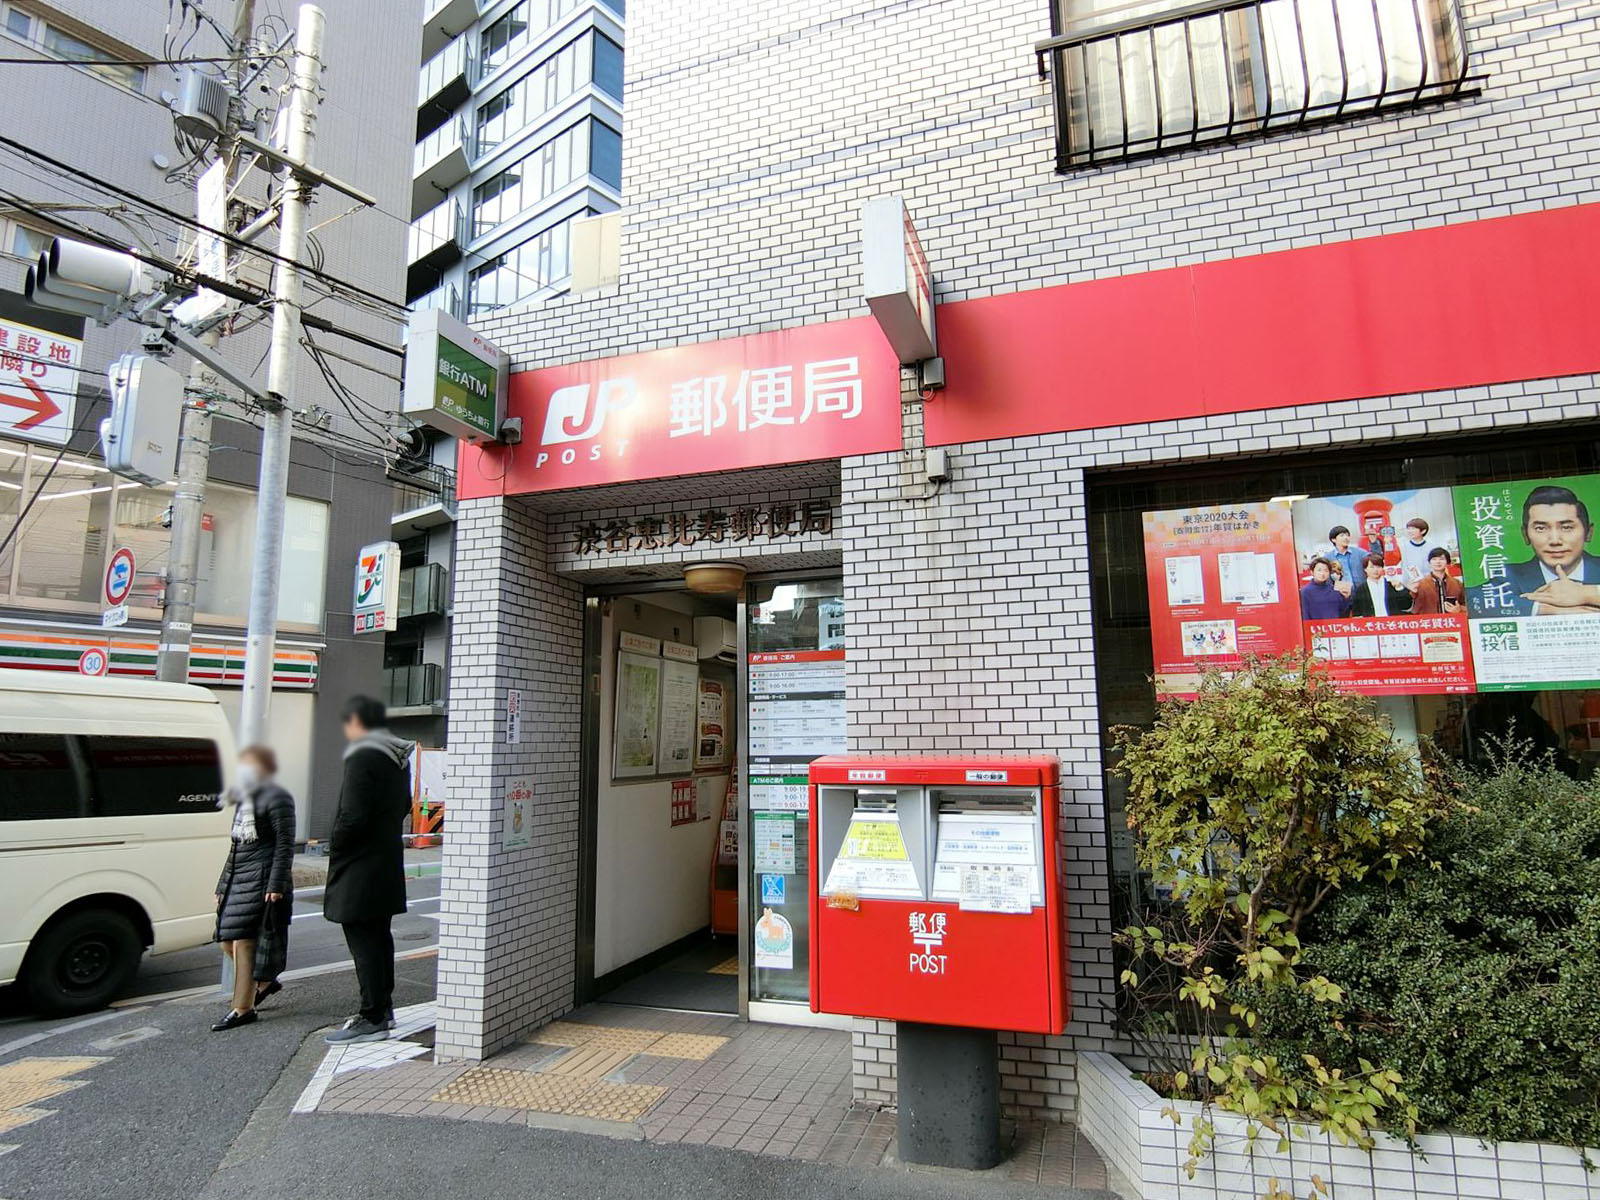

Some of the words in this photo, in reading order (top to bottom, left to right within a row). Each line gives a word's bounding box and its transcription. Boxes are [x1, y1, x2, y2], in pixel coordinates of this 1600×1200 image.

[439, 358, 487, 398] 銀行ATM
[668, 356, 863, 438] 郵便局
[456, 404, 490, 429] ゆうちょ銀行
[535, 438, 630, 469] POST
[1502, 488, 1515, 521] はじめての
[572, 499, 832, 554] 渋谷恵比寿郵便局
[1182, 510, 1249, 525] 東京2020大会
[1470, 495, 1515, 609] 投資信託
[1482, 623, 1516, 633] ゆうちょ
[1481, 634, 1520, 652] 投信
[86, 656, 100, 670] 30
[909, 911, 947, 935] 郵便
[909, 953, 948, 975] POST
